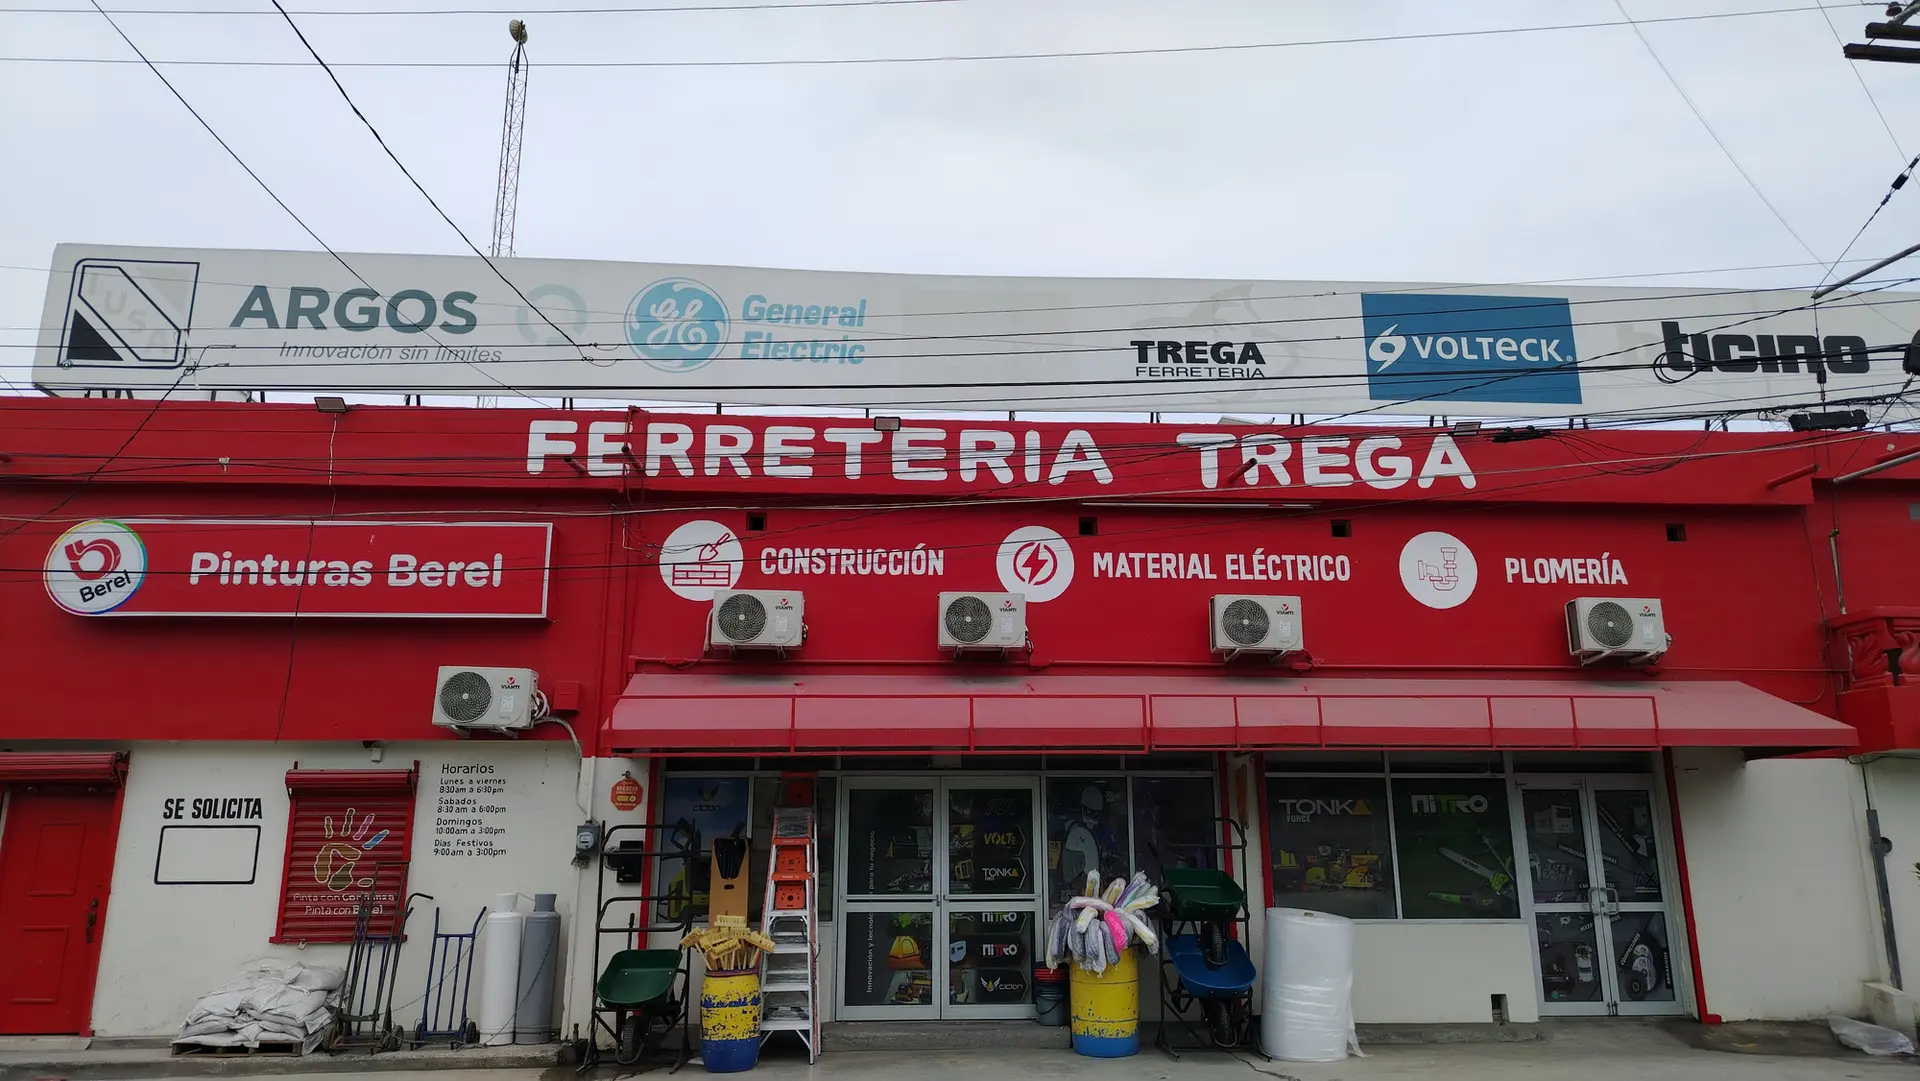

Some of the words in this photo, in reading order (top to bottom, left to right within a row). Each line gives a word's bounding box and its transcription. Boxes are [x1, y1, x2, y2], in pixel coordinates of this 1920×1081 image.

[229, 285, 478, 334] ARGOS
[742, 294, 867, 327] General
[280, 341, 391, 362] Innovación
[400, 345, 428, 362] sin
[740, 331, 866, 365] Electric
[1130, 341, 1266, 365] TREGA
[1136, 367, 1266, 378] FERRETERIA
[526, 419, 1114, 485] FERRETERIA
[1177, 433, 1476, 490] TREGA
[189, 550, 373, 587] Pinturas
[387, 553, 502, 587] Berel
[760, 543, 944, 576] CONSTRUCCIÓN
[1093, 552, 1217, 580] MATERIAL
[1226, 548, 1350, 582] ELÉCTRICO
[1505, 552, 1628, 585] PLOMERÍA
[79, 568, 132, 603] Berel
[442, 764, 494, 774] Horarios
[163, 798, 185, 820] SE
[191, 798, 262, 819] SOLICITA
[438, 797, 477, 805] Sabados
[436, 818, 482, 827] Domingos
[305, 906, 331, 915] Pinta
